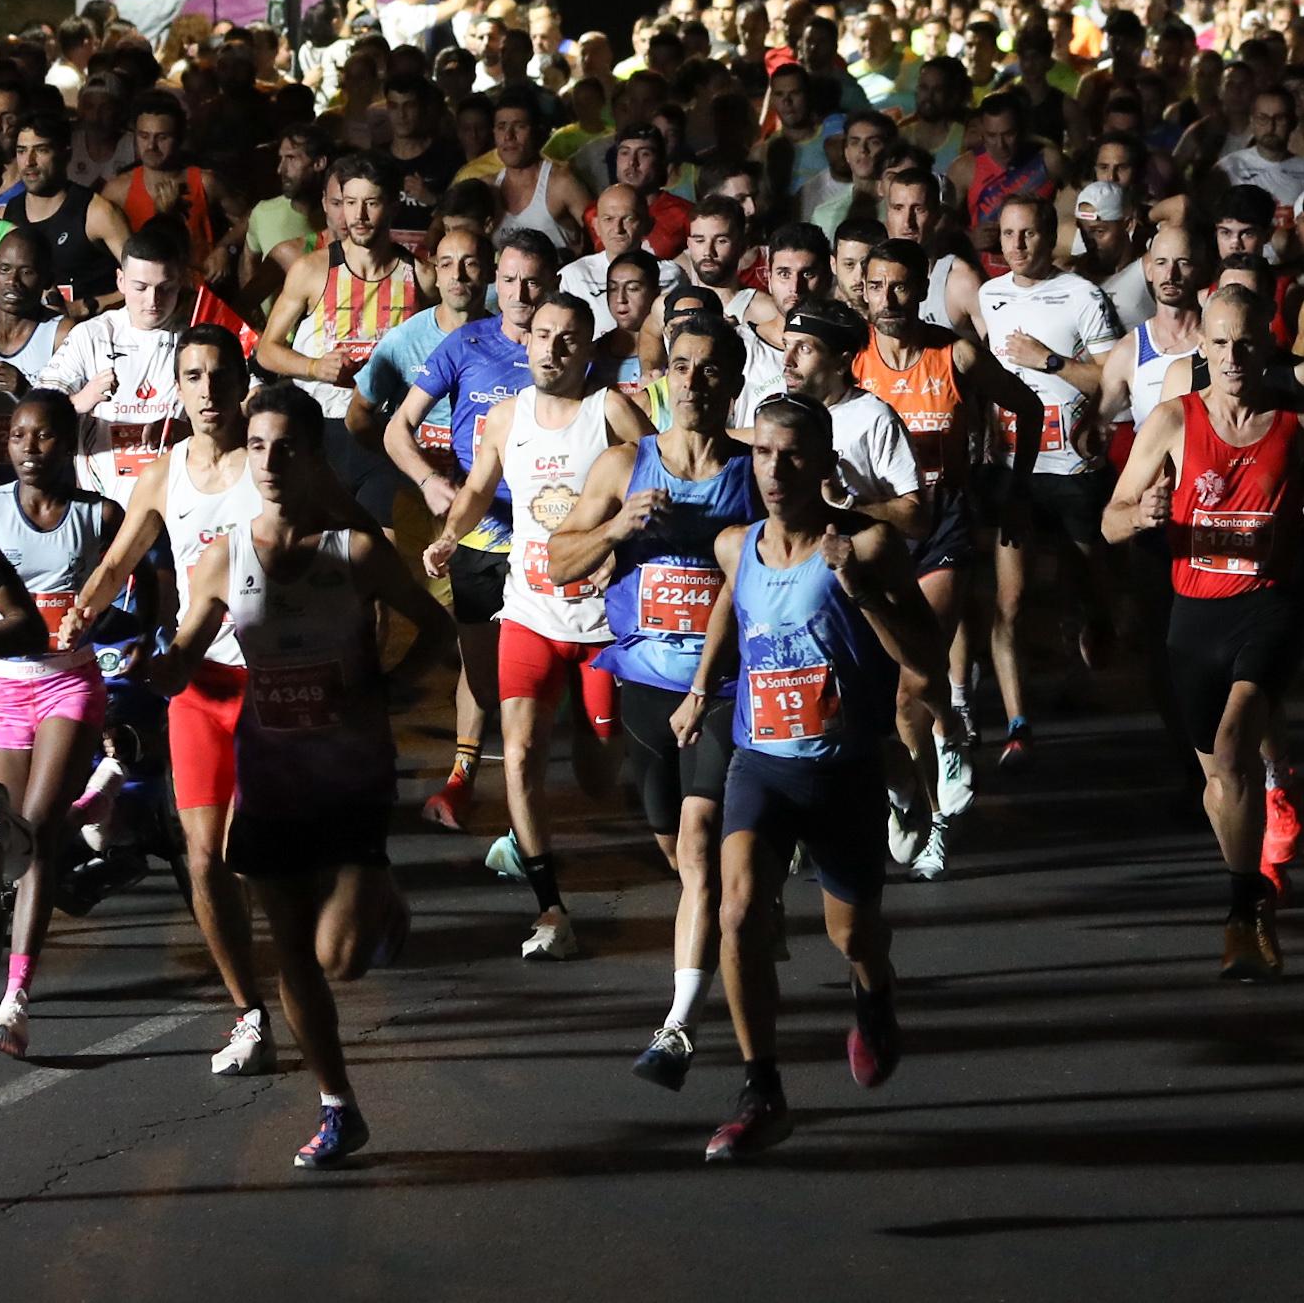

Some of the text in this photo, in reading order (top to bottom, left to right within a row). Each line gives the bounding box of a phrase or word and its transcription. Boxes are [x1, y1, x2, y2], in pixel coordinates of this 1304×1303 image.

[535, 454, 570, 471] CAT
[1213, 517, 1266, 528] Santander
[199, 523, 237, 544] CAT
[1207, 530, 1256, 547] 1769
[665, 572, 721, 585] Santander
[656, 586, 711, 606] 2244
[766, 672, 825, 689] Santander
[268, 685, 325, 704] 4349
[775, 691, 804, 711] 13
